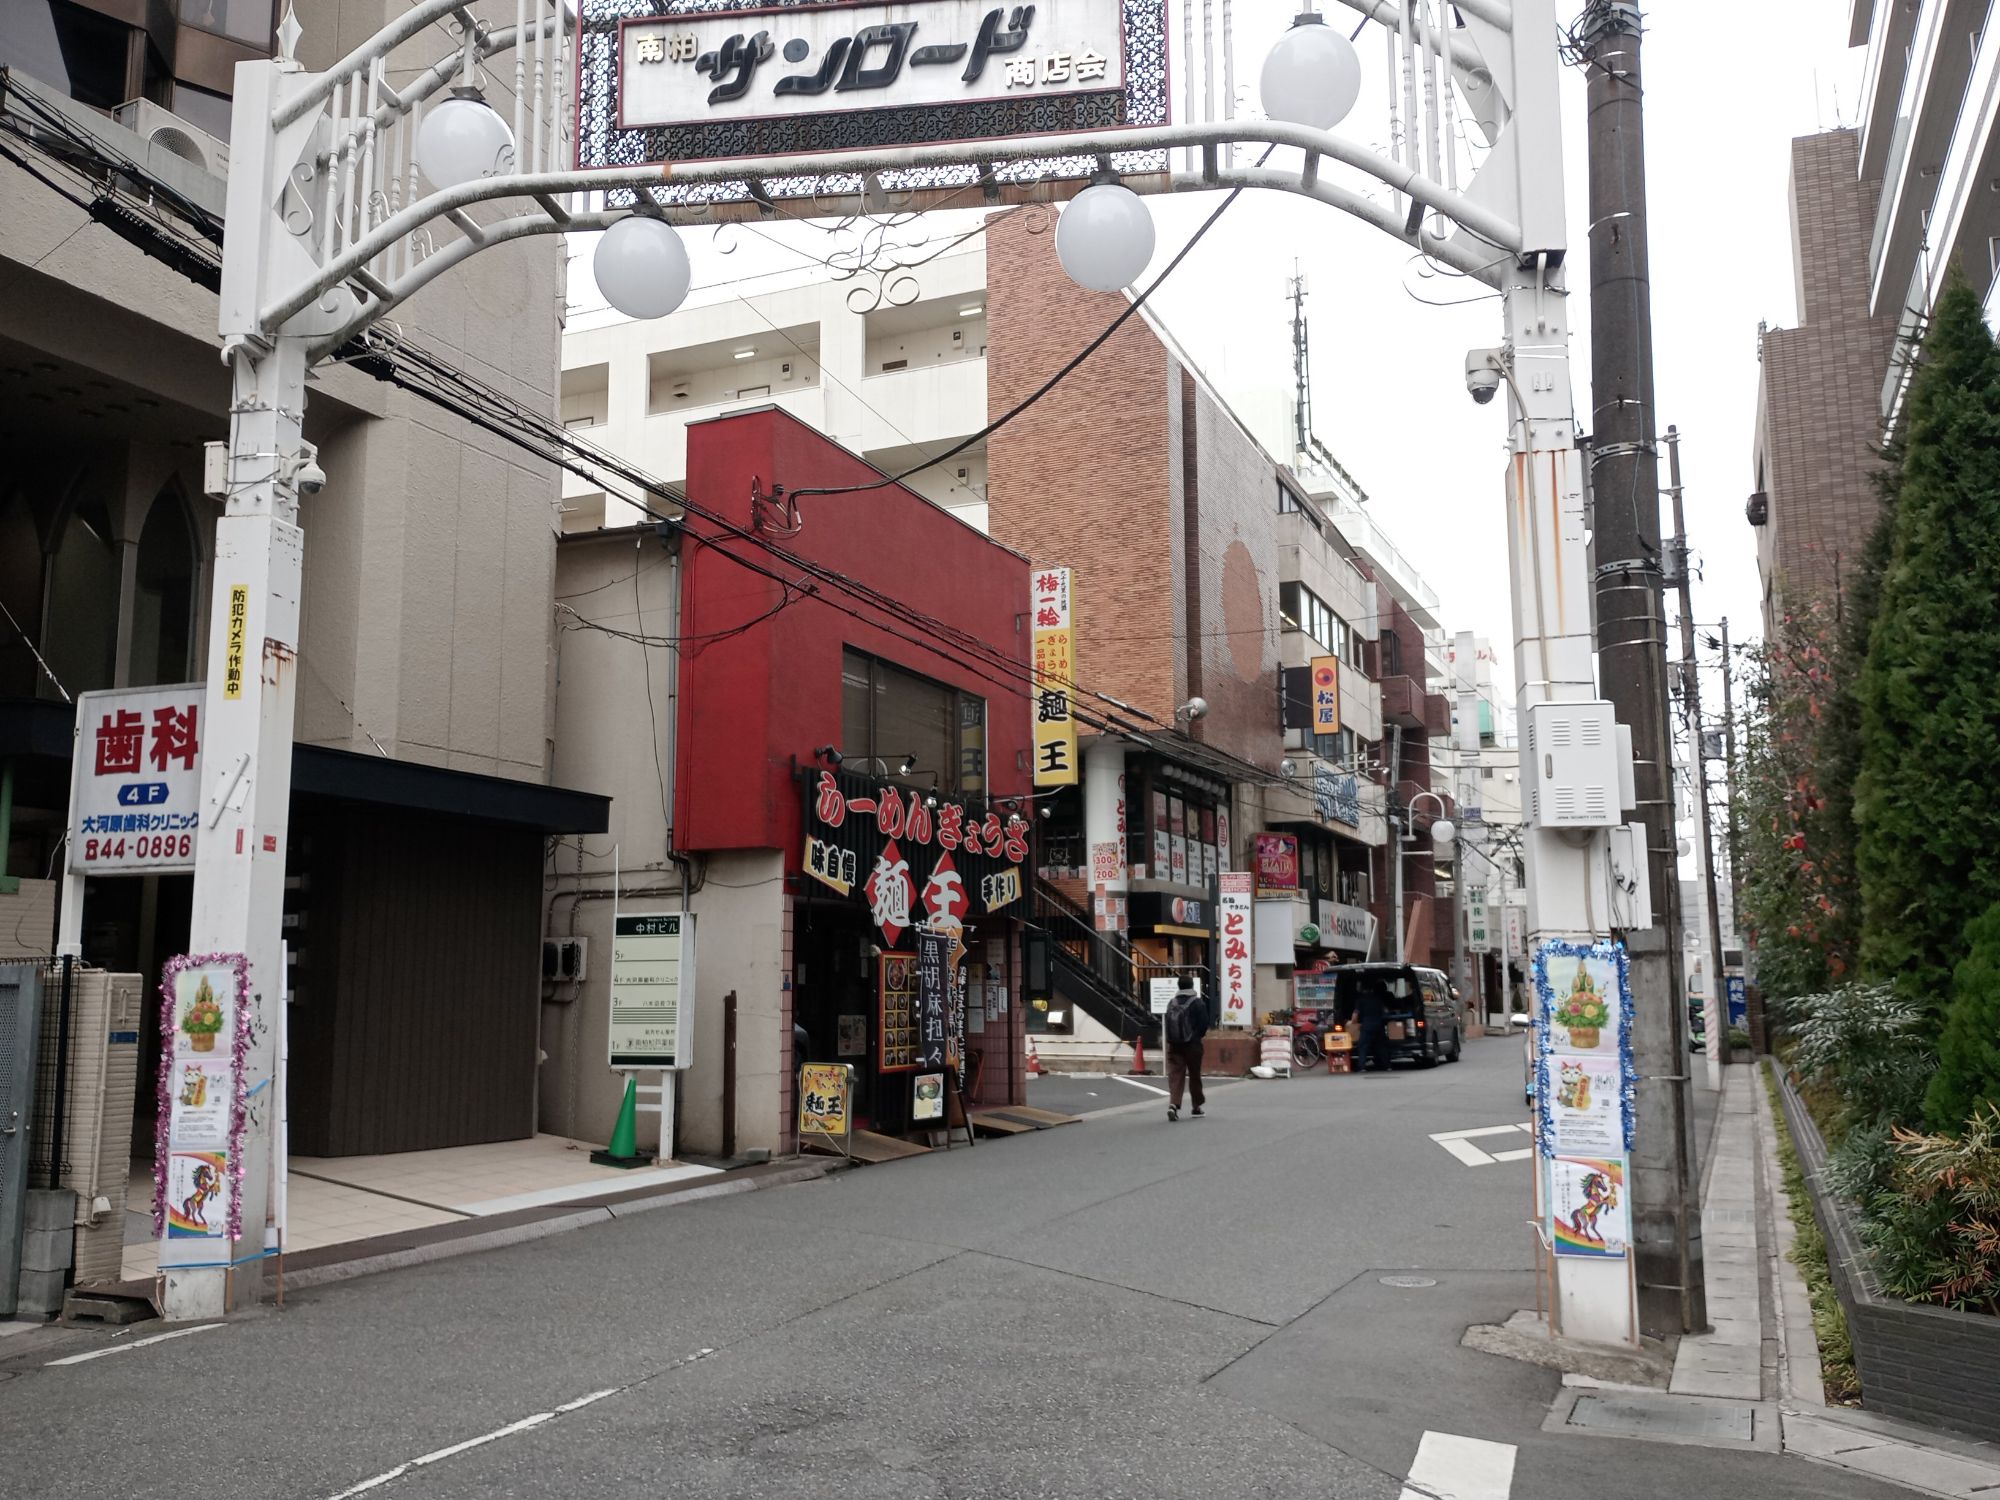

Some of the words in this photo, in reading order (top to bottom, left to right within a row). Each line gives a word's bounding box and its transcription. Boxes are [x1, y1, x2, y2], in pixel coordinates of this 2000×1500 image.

[636, 32, 698, 63] 南柏
[694, 4, 1034, 106] サンロード
[1004, 48, 1106, 87] 商店会
[1036, 574, 1060, 627] 梅一輪
[226, 590, 246, 694] 防犯カメラ作動中
[1047, 634, 1057, 682] ぎょうざ
[1058, 634, 1068, 684] らーめん
[1317, 690, 1334, 723] 松屋
[95, 705, 198, 775] 歯科
[81, 812, 199, 834] 大河原歯科クリニック
[816, 770, 933, 844] らーめん
[935, 802, 1030, 863] ぎょうざ
[810, 840, 856, 887] 味自慢
[981, 873, 1019, 904] 手作り
[635, 922, 678, 934] 中村ビル
[615, 950, 624, 959] 5F
[1224, 912, 1248, 1009] とみちゃん
[922, 940, 945, 1066] 黒胡麻担々
